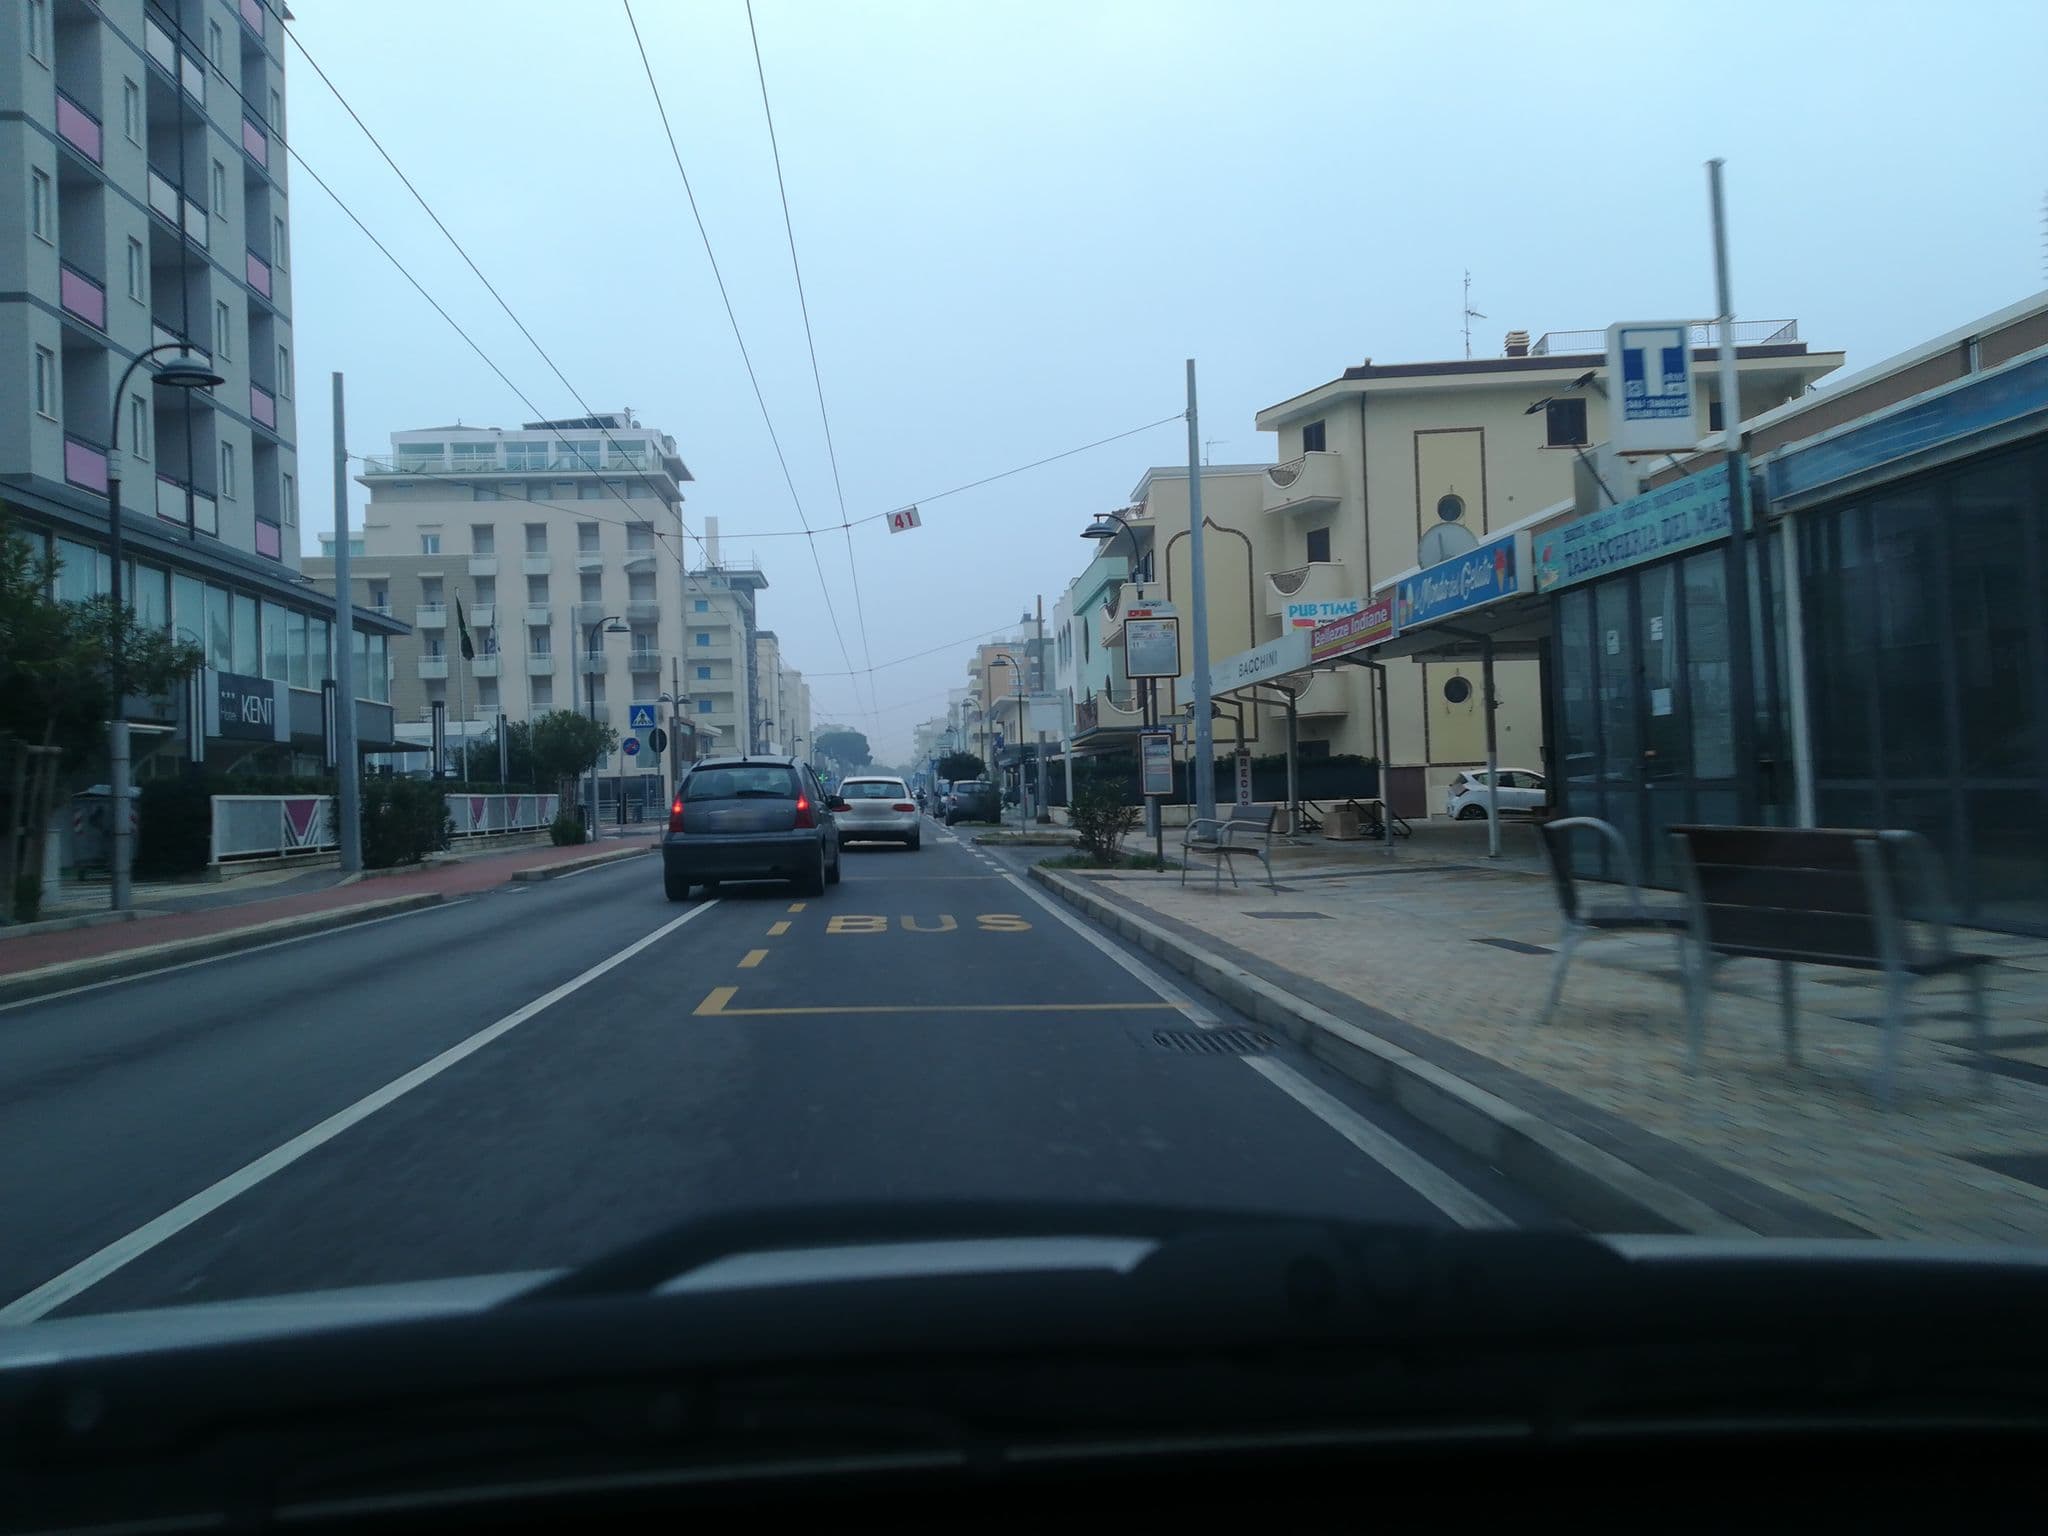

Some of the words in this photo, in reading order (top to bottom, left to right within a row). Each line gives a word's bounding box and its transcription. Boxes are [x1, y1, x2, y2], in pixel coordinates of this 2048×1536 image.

[894, 511, 914, 529] 41
[1460, 555, 1494, 600] Gelato
[1288, 604, 1318, 618] PUB
[1319, 601, 1358, 616] TIME
[1314, 624, 1350, 648] Bellezze
[1351, 607, 1388, 635] Indiane
[241, 694, 274, 726] KENT
[826, 913, 1033, 935] BUS
